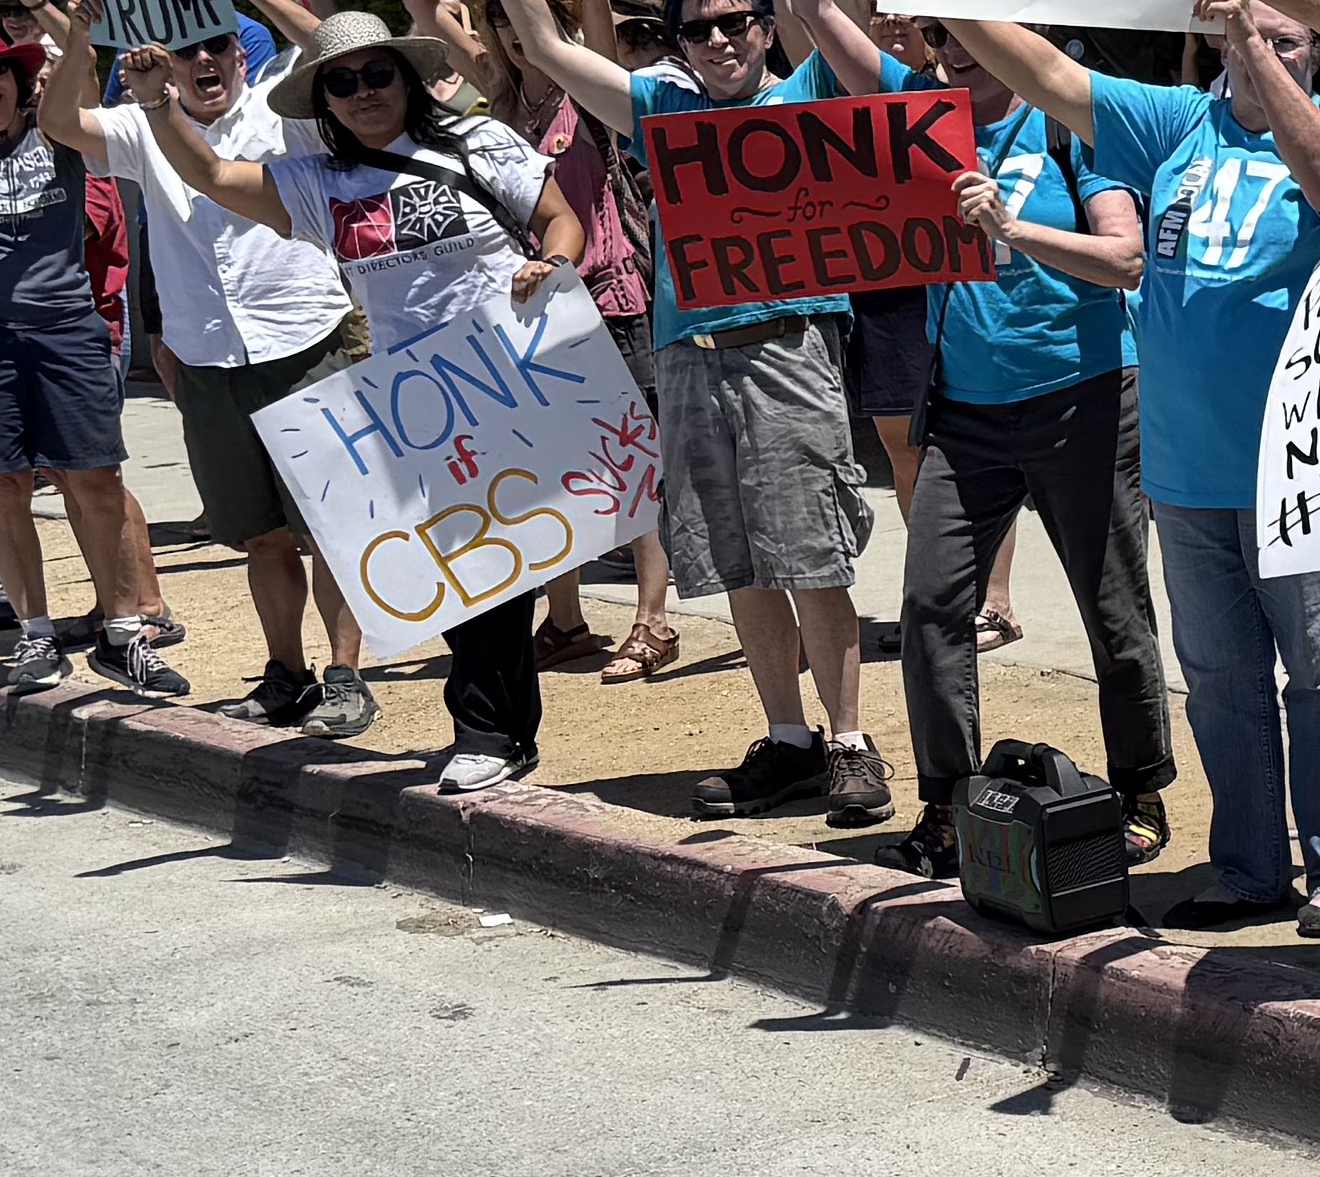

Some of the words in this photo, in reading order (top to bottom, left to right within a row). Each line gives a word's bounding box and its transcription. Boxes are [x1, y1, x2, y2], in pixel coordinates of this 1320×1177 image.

[651, 99, 965, 205] HONK
[433, 237, 476, 257] GUILD
[787, 187, 834, 223] for
[1158, 210, 1187, 259] AFM
[1188, 157, 1291, 270] 47
[668, 215, 991, 302] FREEDOM
[320, 285, 586, 476] HONK
[444, 434, 480, 486] if
[561, 401, 659, 515] SUCKS
[360, 467, 574, 622] CBS
